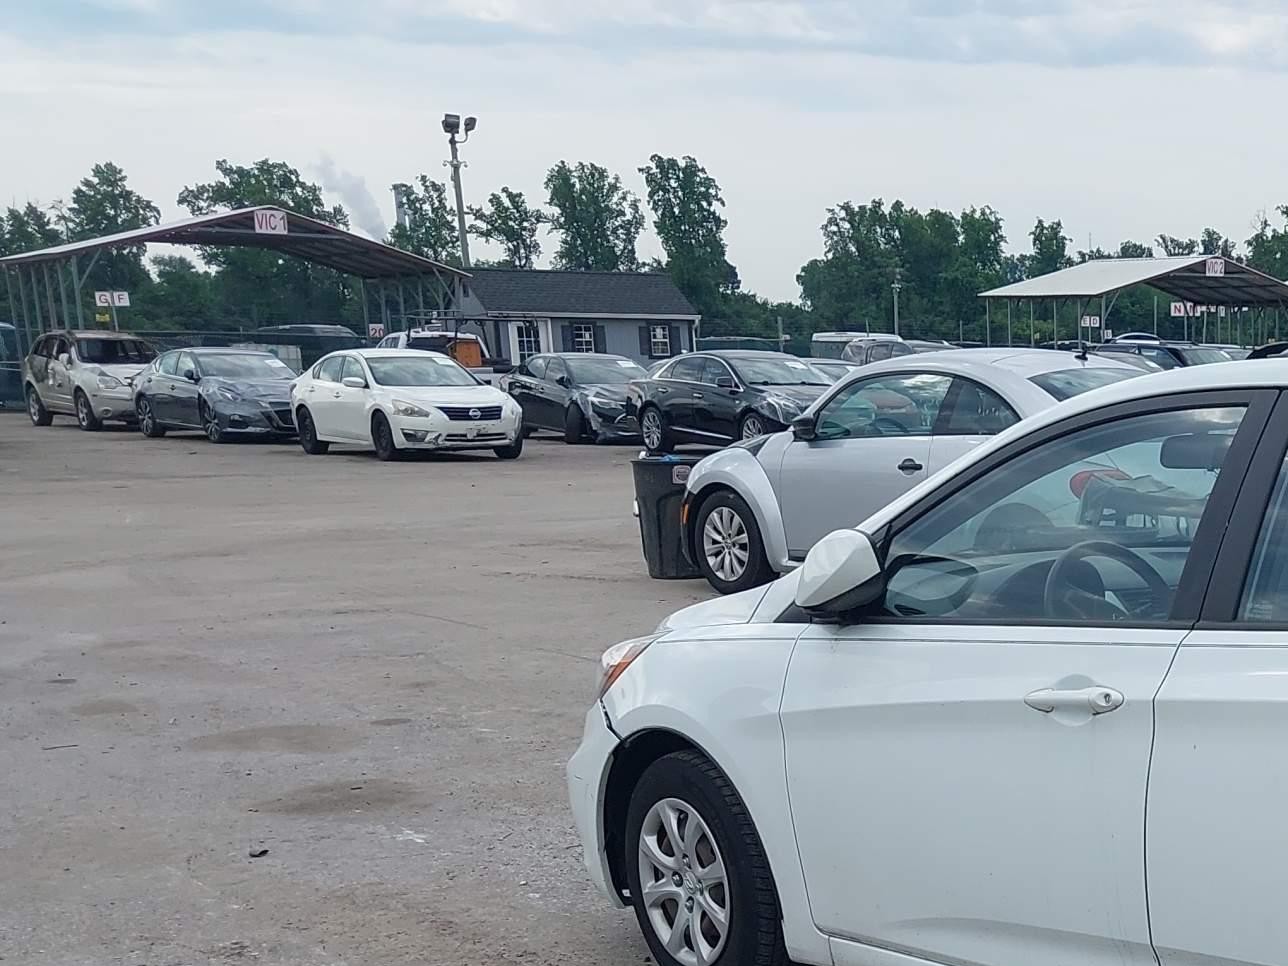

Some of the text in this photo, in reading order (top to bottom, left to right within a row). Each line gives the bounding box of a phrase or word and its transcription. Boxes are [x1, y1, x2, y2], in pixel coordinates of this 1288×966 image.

[256, 212, 287, 231] VIC 1
[1208, 261, 1218, 274] VIC
[98, 294, 108, 304] G
[117, 294, 125, 304] F
[1173, 304, 1182, 314] N
[1092, 317, 1098, 325] D
[371, 327, 384, 337] 20
